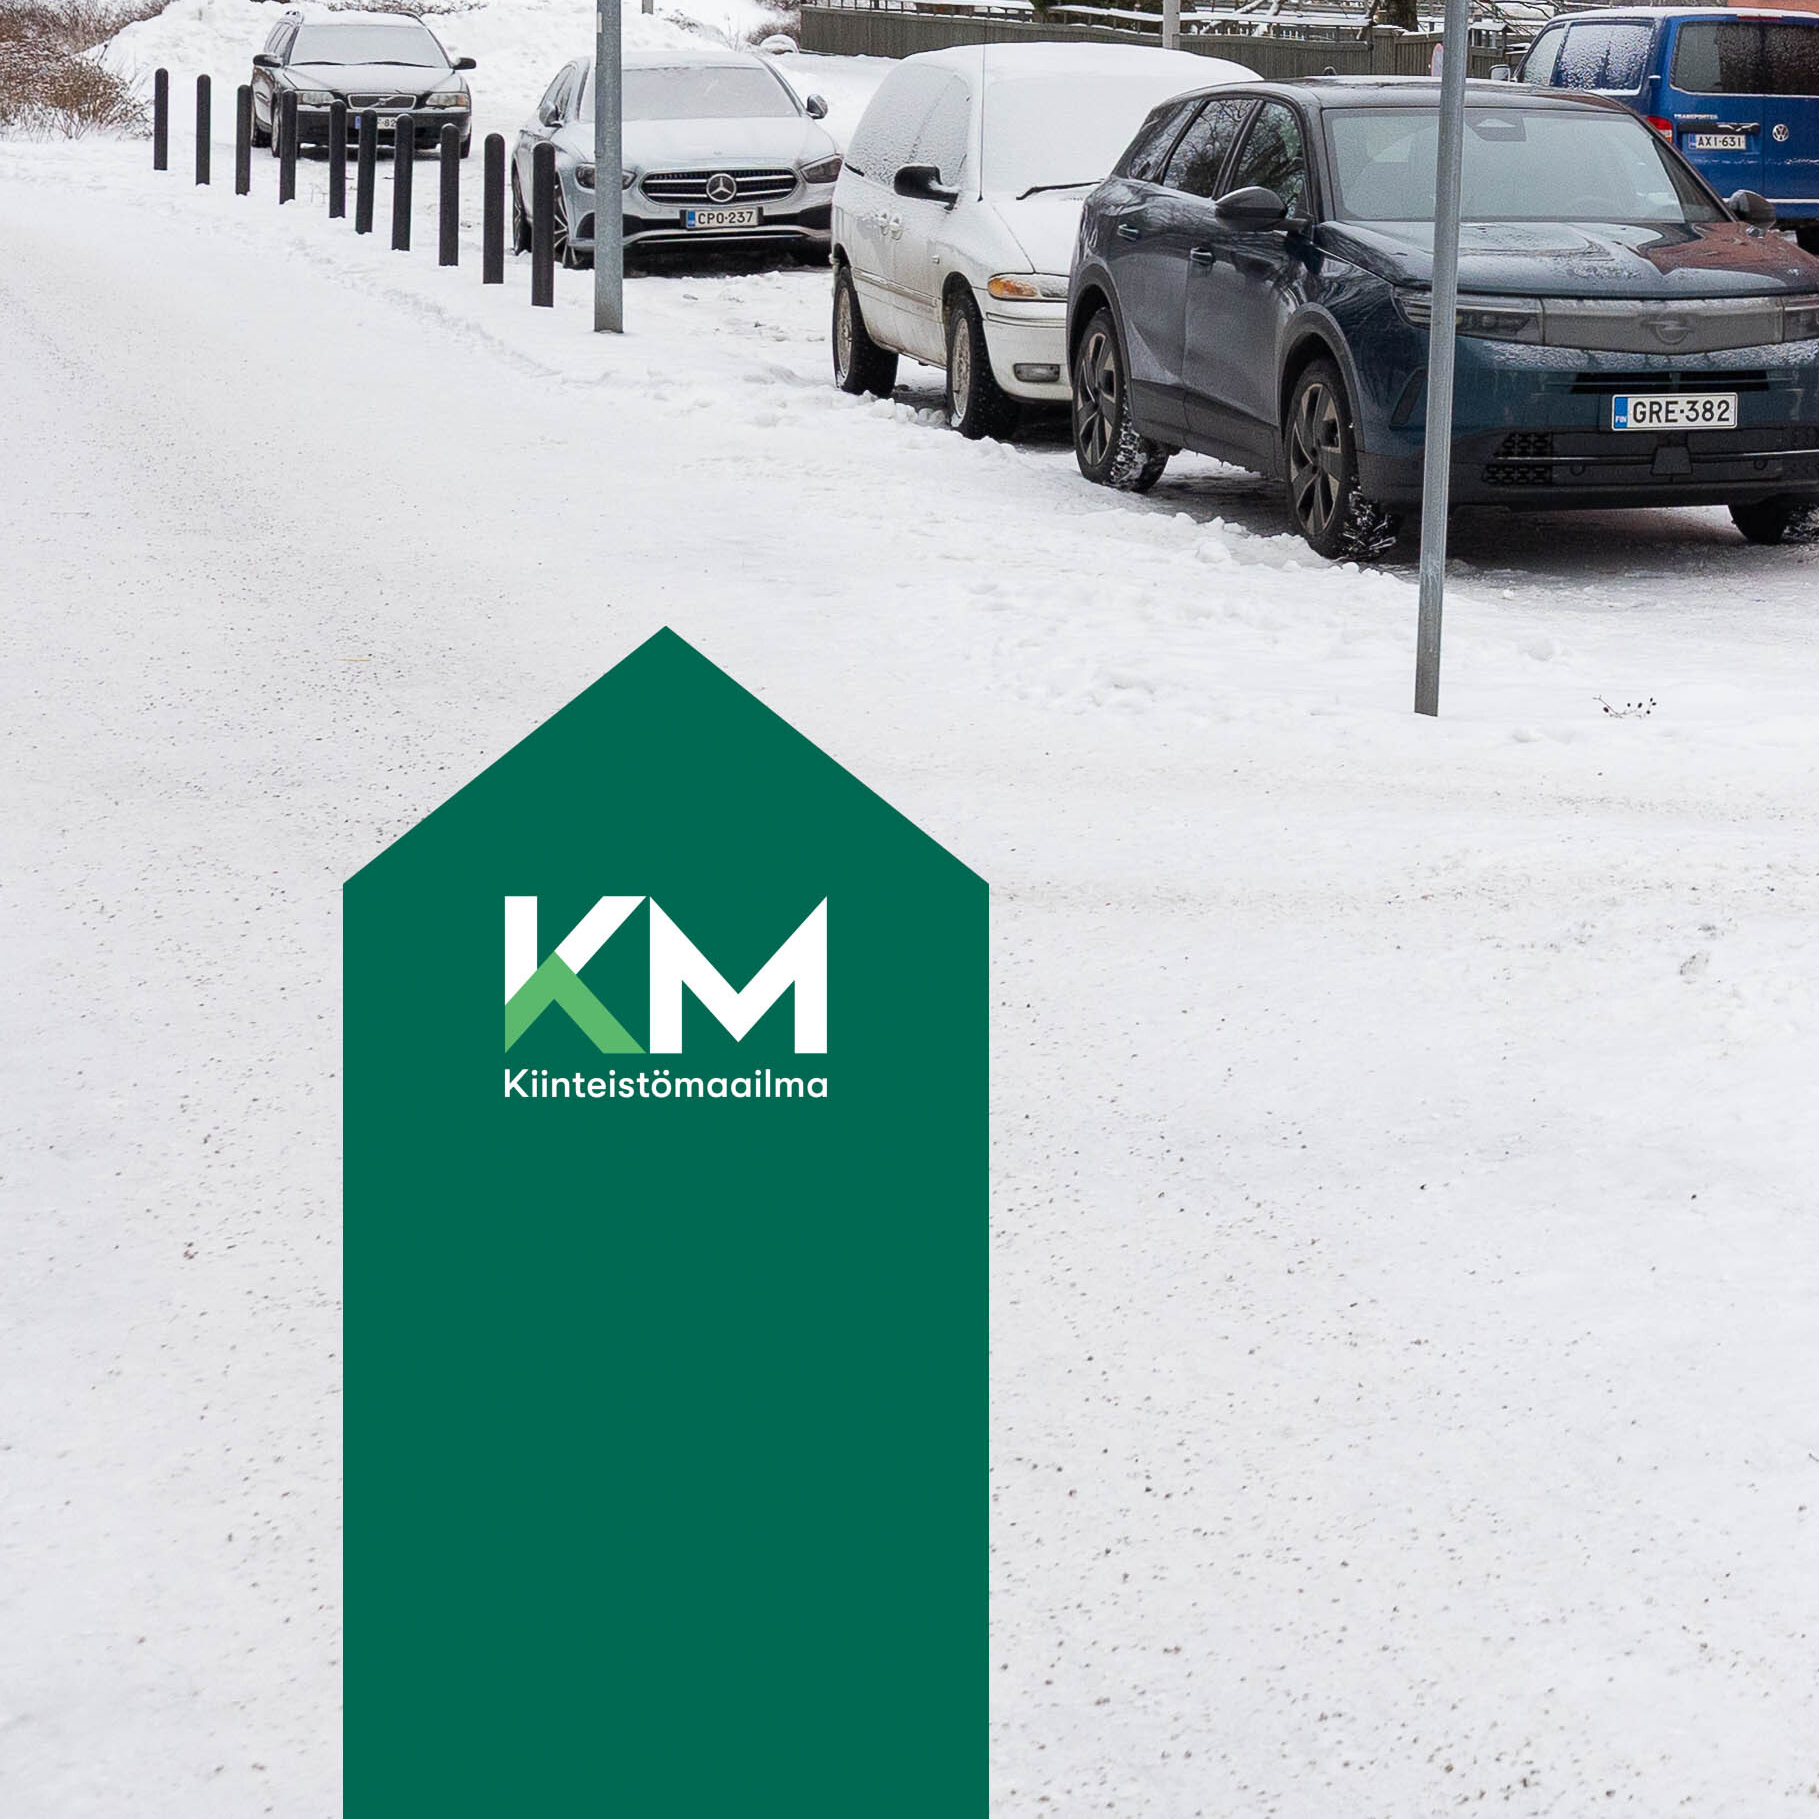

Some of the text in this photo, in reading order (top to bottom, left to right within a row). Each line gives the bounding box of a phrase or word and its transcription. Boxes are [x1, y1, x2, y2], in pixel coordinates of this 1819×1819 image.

[1697, 136, 1742, 147] AXI-631
[698, 211, 754, 225] CPO-237
[1633, 400, 1730, 423] GRE-382
